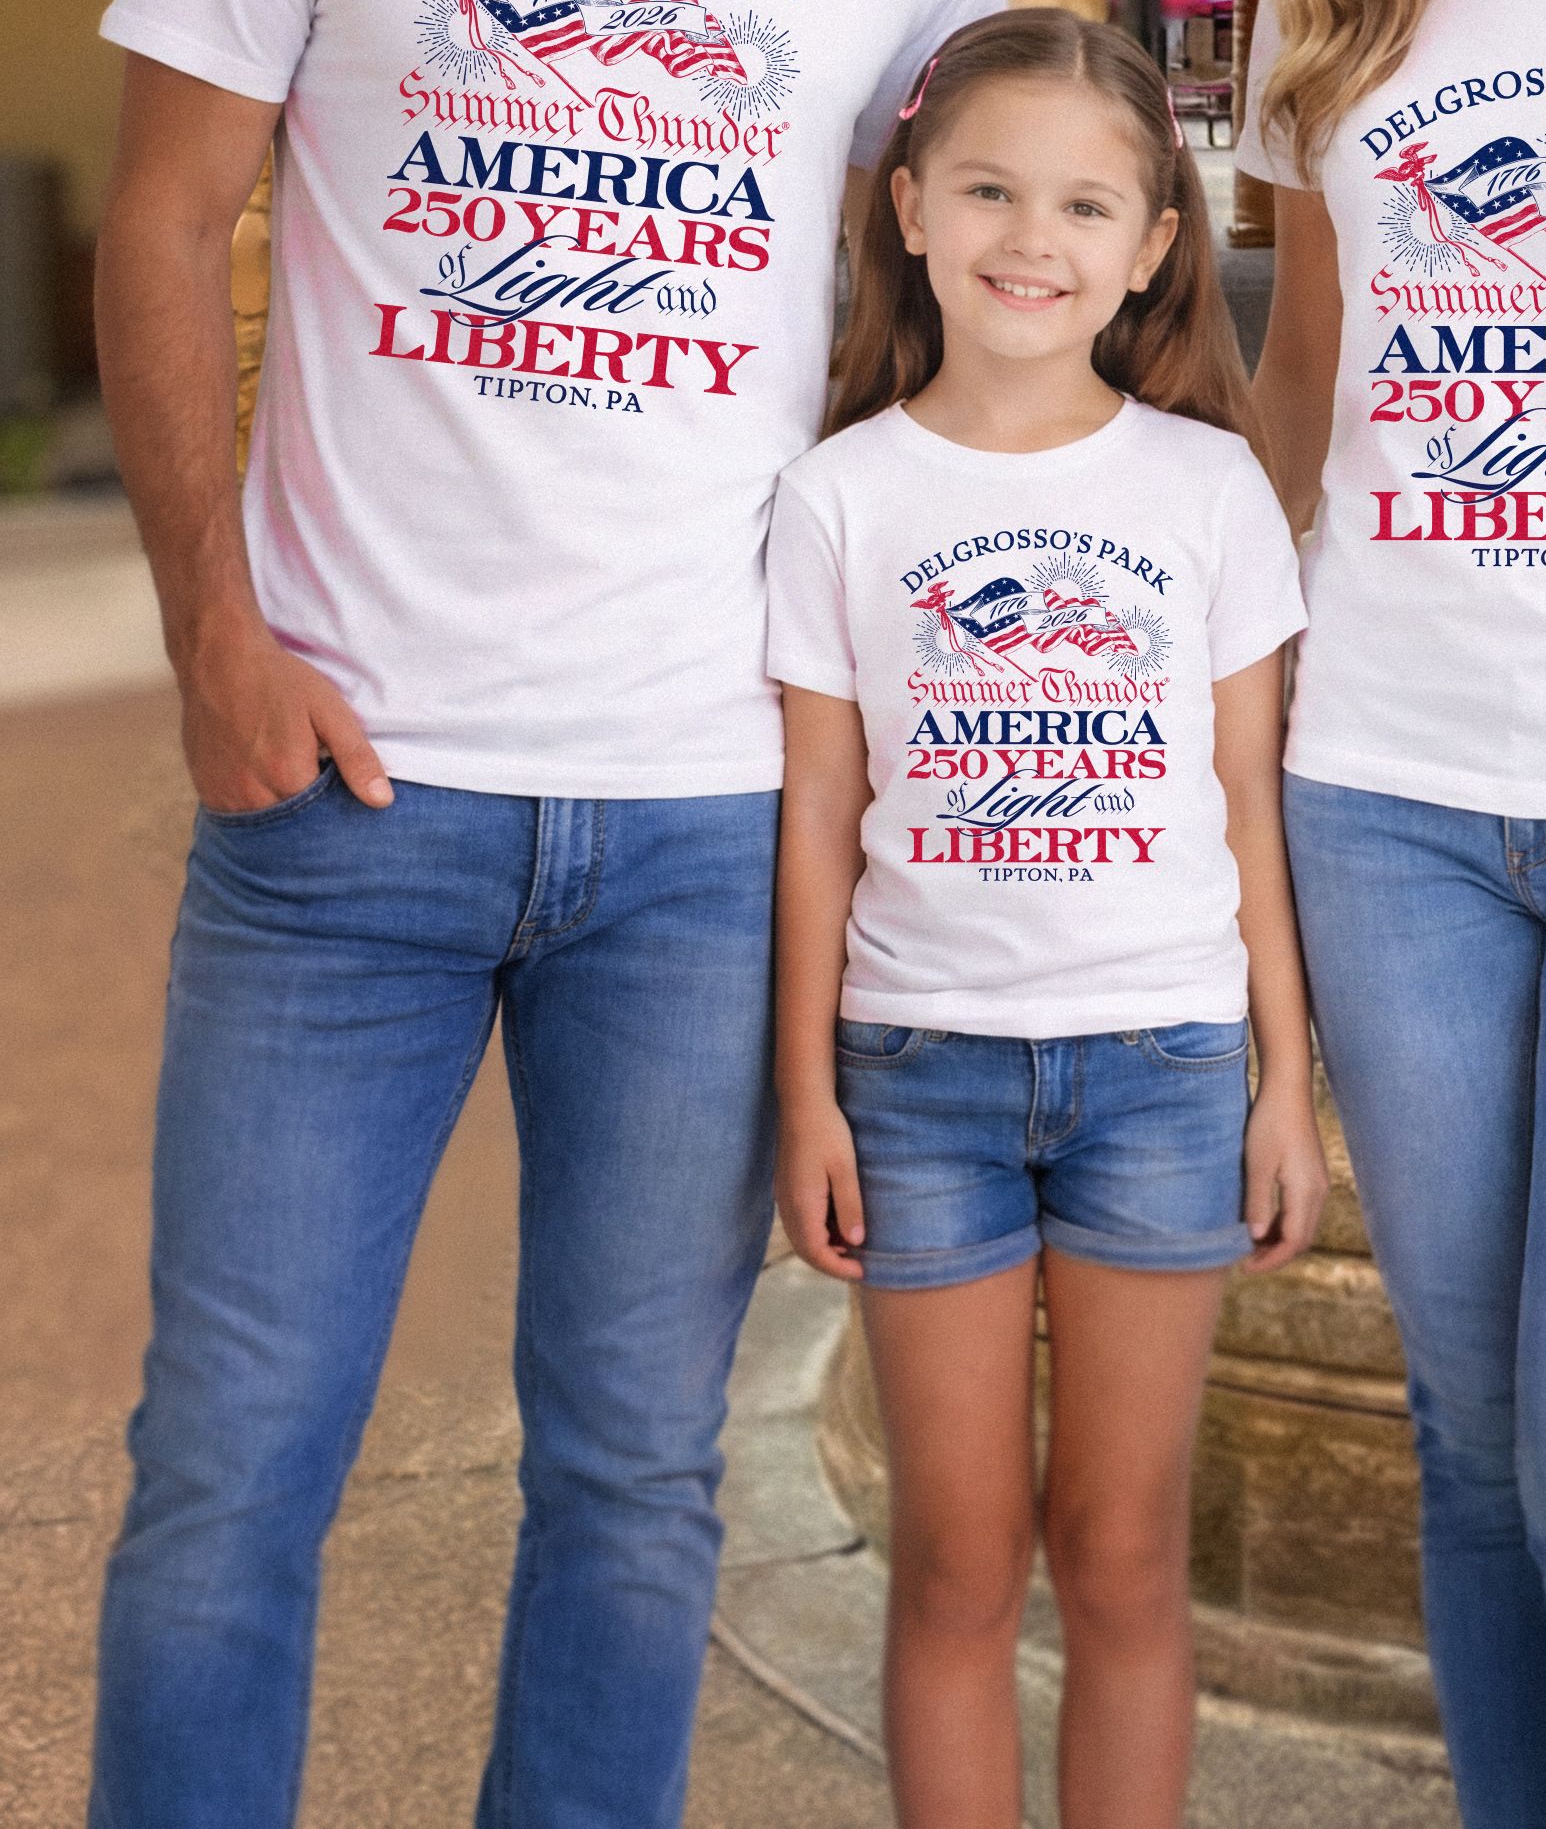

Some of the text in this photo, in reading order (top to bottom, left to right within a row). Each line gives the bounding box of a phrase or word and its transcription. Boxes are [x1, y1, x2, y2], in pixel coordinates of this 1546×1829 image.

[601, 6, 678, 30] 2026
[399, 67, 588, 144] Summer
[387, 130, 775, 222] AMERICA
[1487, 162, 1542, 196] 1776
[383, 188, 771, 272] 250 YEARS
[420, 235, 717, 327] of Light and
[369, 303, 759, 396] LIBERTY
[474, 375, 644, 414] TIPTON, PA
[1370, 380, 1484, 422] 250
[1427, 422, 1455, 469] of
[900, 528, 1173, 595] DELGROSSO'S PARK
[989, 596, 1032, 620] 1776
[1041, 608, 1088, 628] 2026
[907, 668, 1034, 707] Summer
[906, 710, 1167, 745] AMERICA
[907, 749, 1166, 779] 250 YEARS
[936, 769, 1136, 837] of Light and
[907, 828, 1166, 863] LIBERTY
[979, 867, 1094, 883] TIPTON, PA
